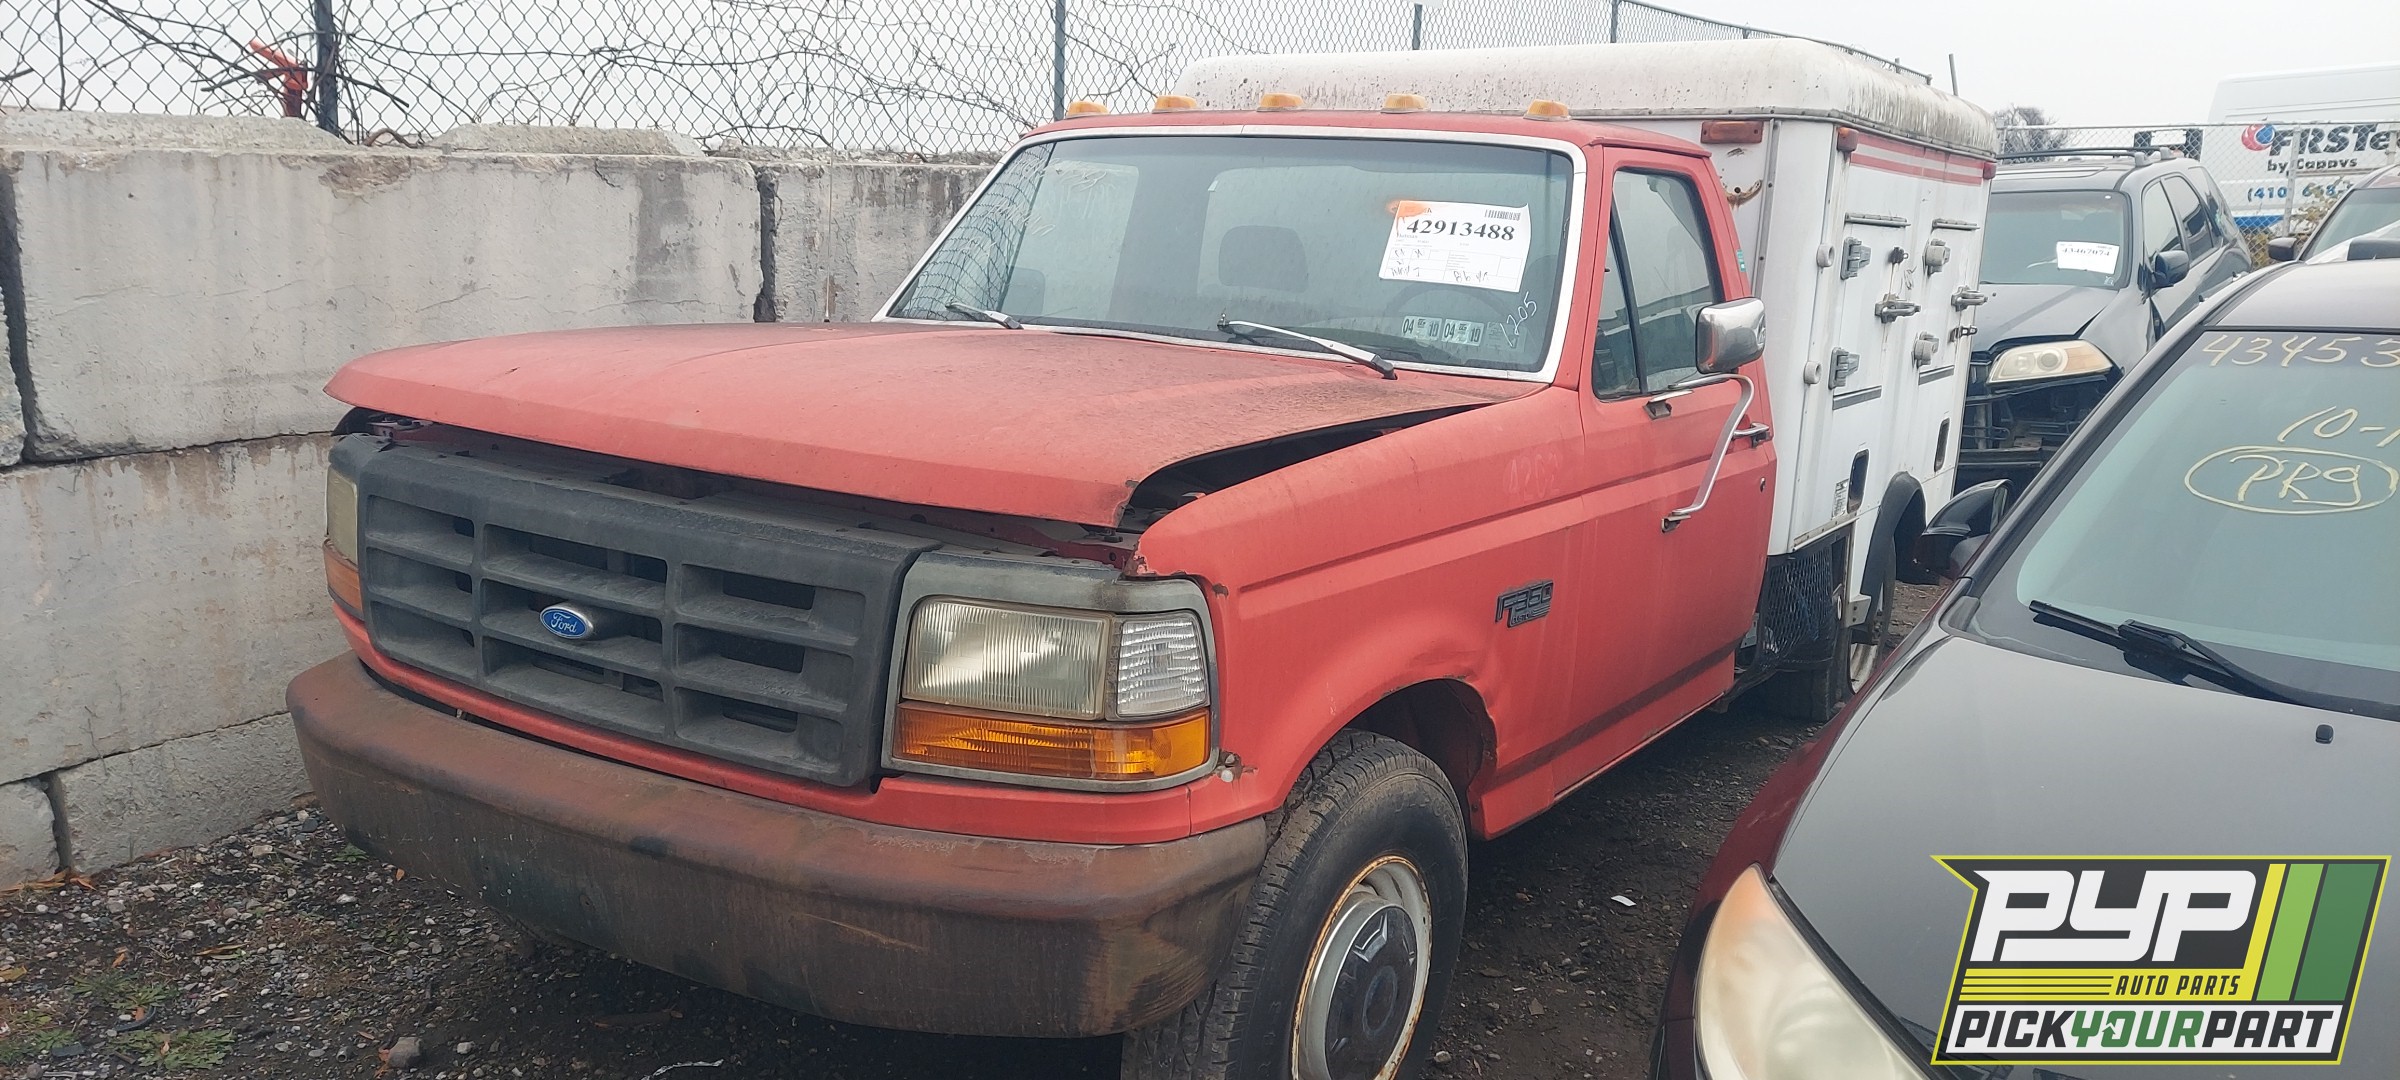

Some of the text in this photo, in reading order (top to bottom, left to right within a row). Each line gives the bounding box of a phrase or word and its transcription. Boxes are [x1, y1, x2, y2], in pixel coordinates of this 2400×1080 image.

[2267, 159, 2288, 174] by
[1406, 219, 1515, 241] 42913488
[1402, 318, 1415, 335] 04
[1500, 291, 1538, 347] 1205
[1443, 322, 1456, 339] 04
[550, 612, 578, 633] Ford
